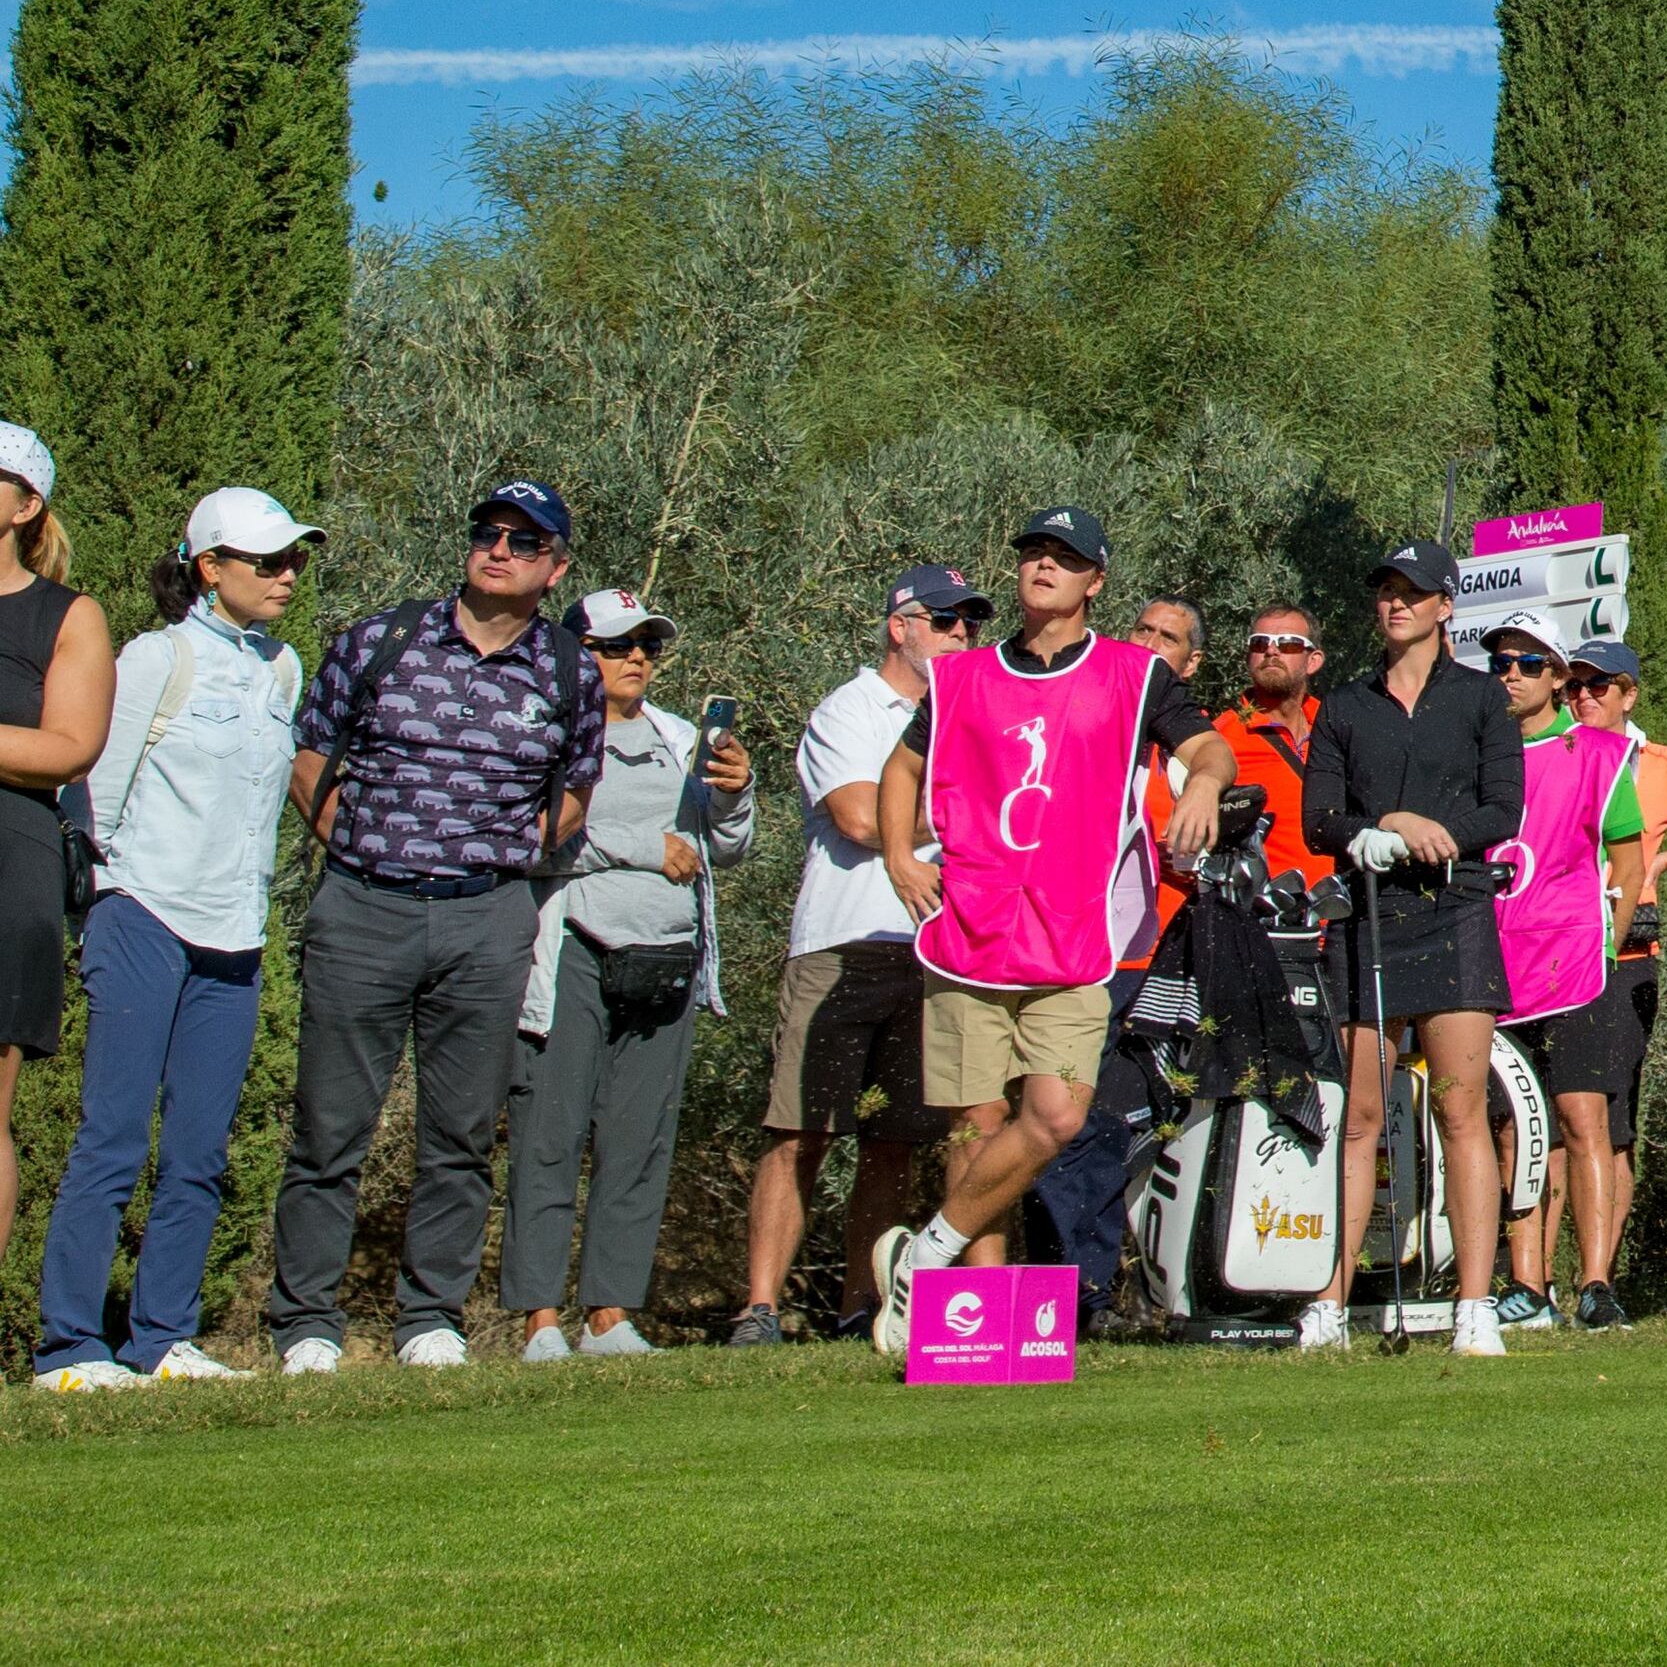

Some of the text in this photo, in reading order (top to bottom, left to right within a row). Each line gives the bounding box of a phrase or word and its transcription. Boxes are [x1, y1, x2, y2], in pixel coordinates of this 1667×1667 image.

[496, 481, 548, 502] Callaway
[1507, 512, 1569, 540] Andalucía
[1456, 566, 1522, 596] GANDA
[1594, 547, 1616, 586] L
[1451, 597, 1612, 645] TARK L
[1290, 985, 1318, 1006] NG
[1508, 1058, 1543, 1195] TOPGOLF
[1275, 1213, 1325, 1240] ASU
[1210, 1328, 1295, 1340] PLAY YOUR BEST
[933, 1356, 957, 1364] COSTA
[1020, 1341, 1068, 1357] ACOSOL
